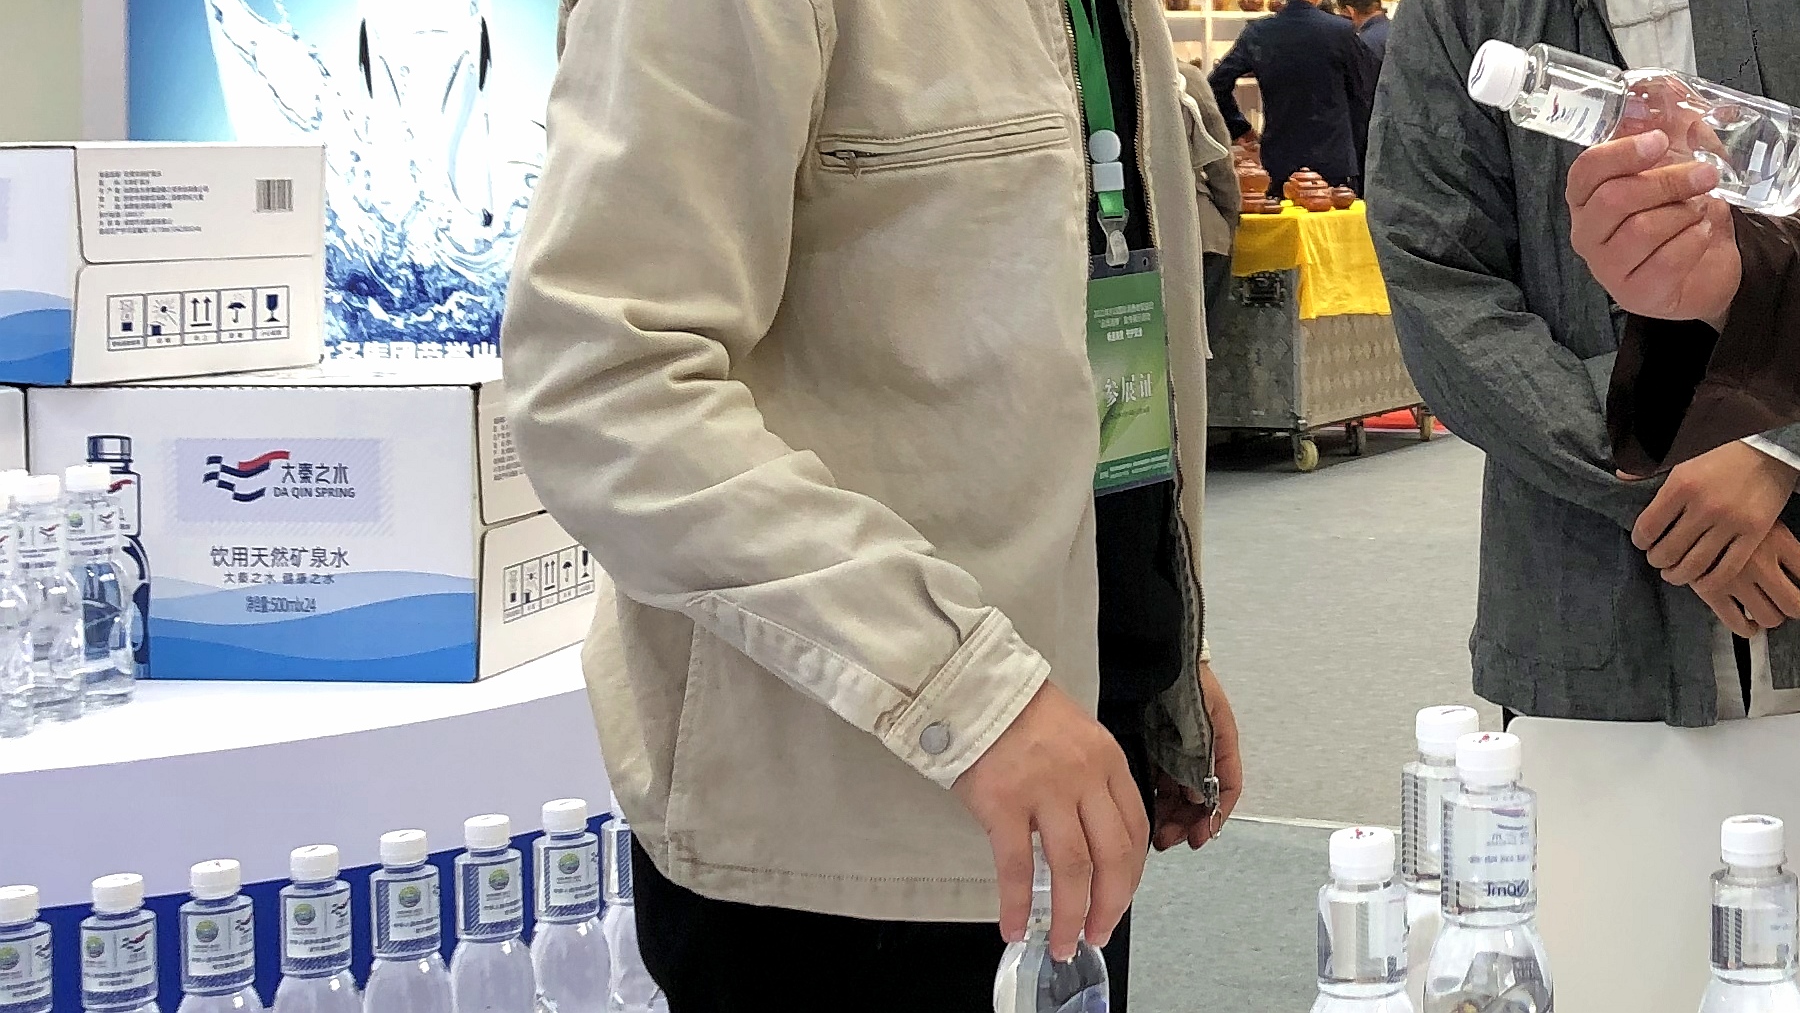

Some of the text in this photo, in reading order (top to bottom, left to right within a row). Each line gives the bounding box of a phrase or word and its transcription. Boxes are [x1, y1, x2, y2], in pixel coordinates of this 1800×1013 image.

[281, 463, 349, 485] 大秦之水
[273, 487, 356, 500] DA QIN SPRING
[210, 546, 350, 568] 饮用天然矿泉水
